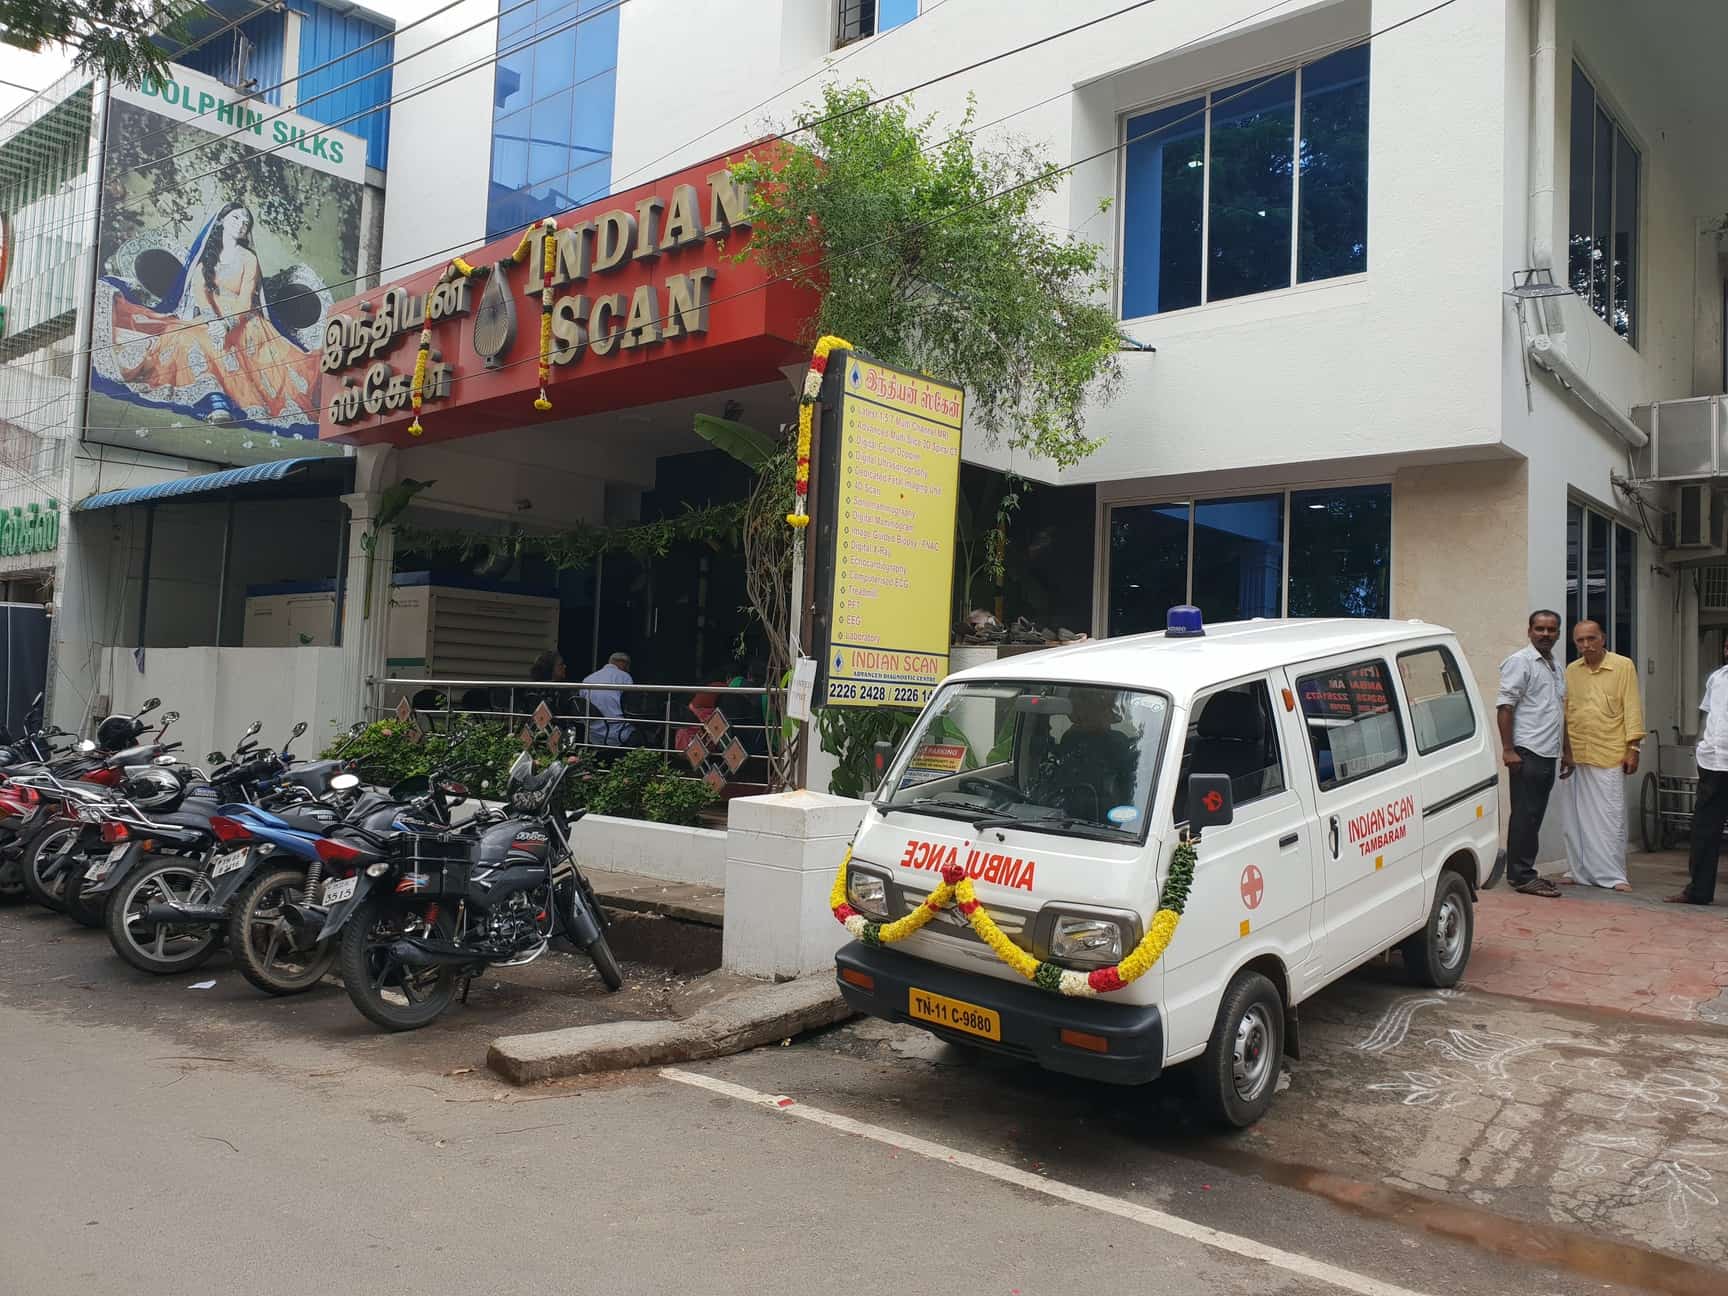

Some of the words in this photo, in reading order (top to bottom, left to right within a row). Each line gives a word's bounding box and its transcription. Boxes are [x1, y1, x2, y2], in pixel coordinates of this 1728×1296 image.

[141, 71, 262, 137] DOLPHIN
[273, 120, 344, 164] SILKS
[524, 169, 752, 296] INDIAN
[551, 266, 716, 366] SCAN
[846, 615, 861, 626] EEG
[845, 631, 881, 643] Laboratory
[851, 650, 899, 671] INDIAN
[903, 655, 938, 673] SCAN
[854, 671, 883, 679] ADVANCED
[883, 673, 916, 681] DIAGNOSTIC
[829, 683, 856, 698] 2226
[860, 686, 885, 700] 2428
[894, 688, 919, 702] 2226
[1348, 808, 1385, 843] INDIAN
[1387, 794, 1414, 825] SCAN
[1359, 824, 1407, 856] TAMBARAM
[916, 998, 947, 1020] TN-11
[952, 1007, 991, 1033] C-9880
